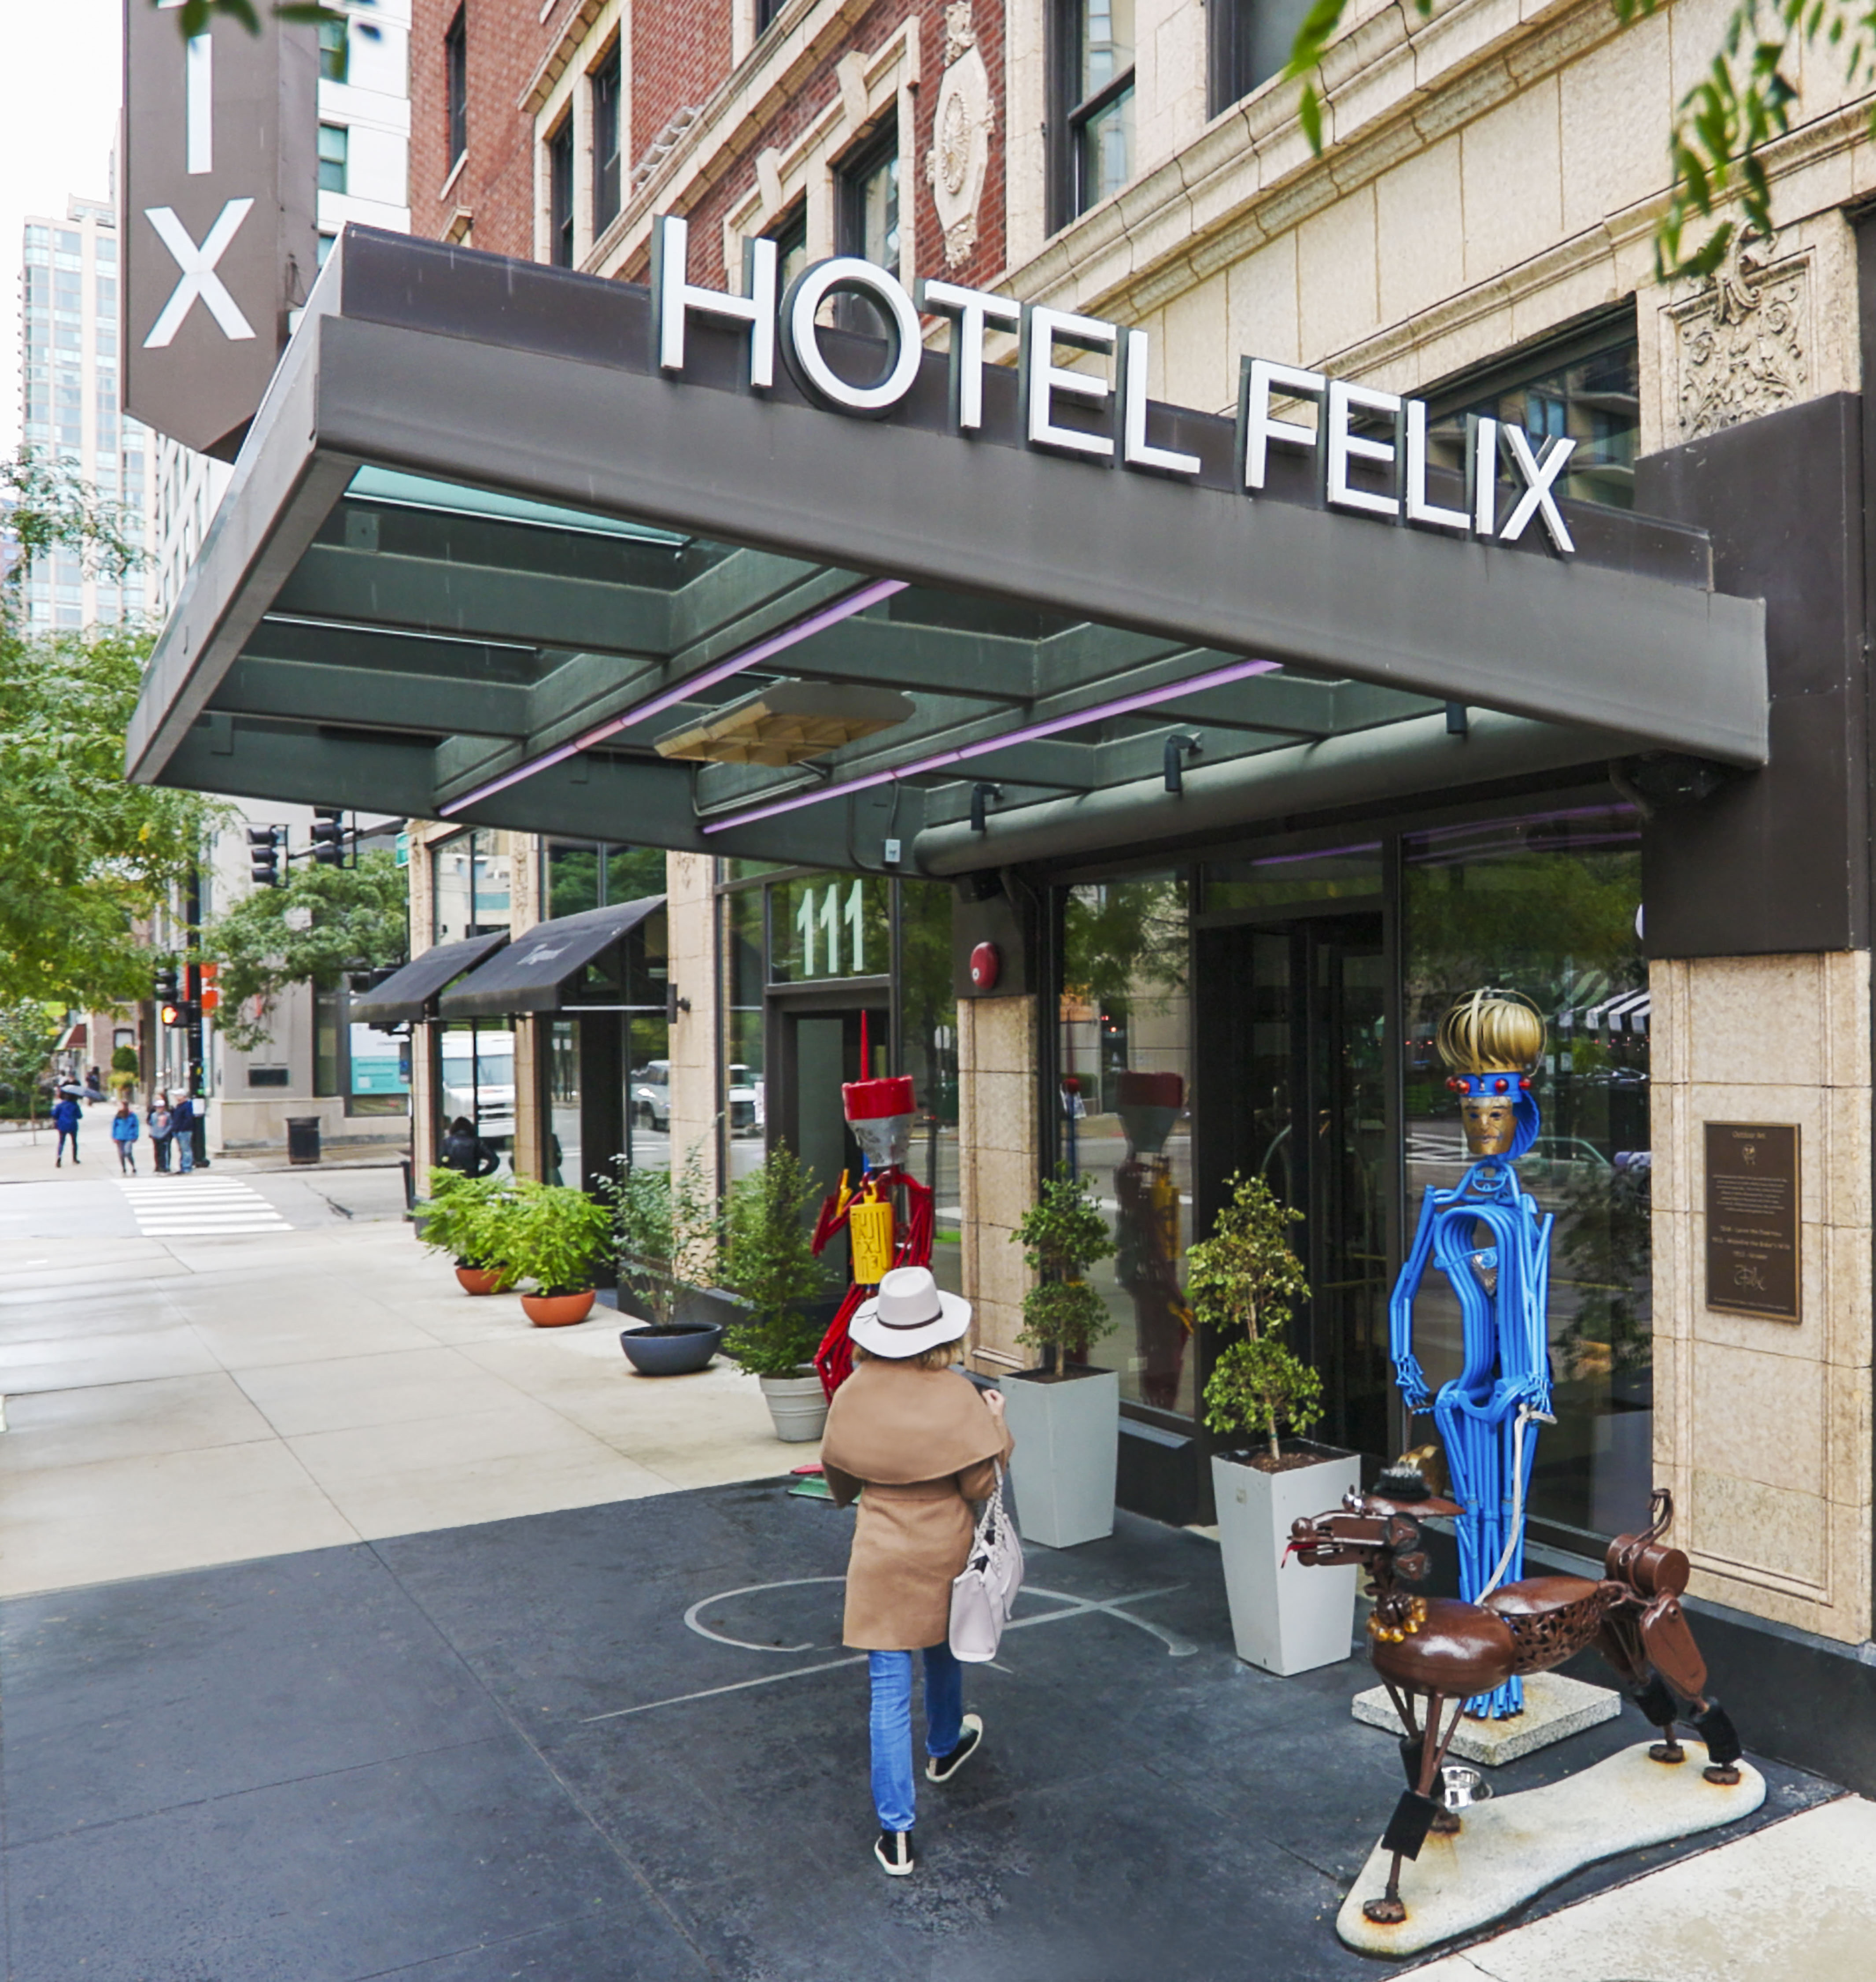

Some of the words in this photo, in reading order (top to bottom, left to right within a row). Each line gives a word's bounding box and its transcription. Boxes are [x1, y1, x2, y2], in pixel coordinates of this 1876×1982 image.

[143, 0, 257, 348] IX
[661, 215, 1201, 474] HOTEL
[1245, 359, 1577, 552] FELIX
[797, 878, 864, 976] 111
